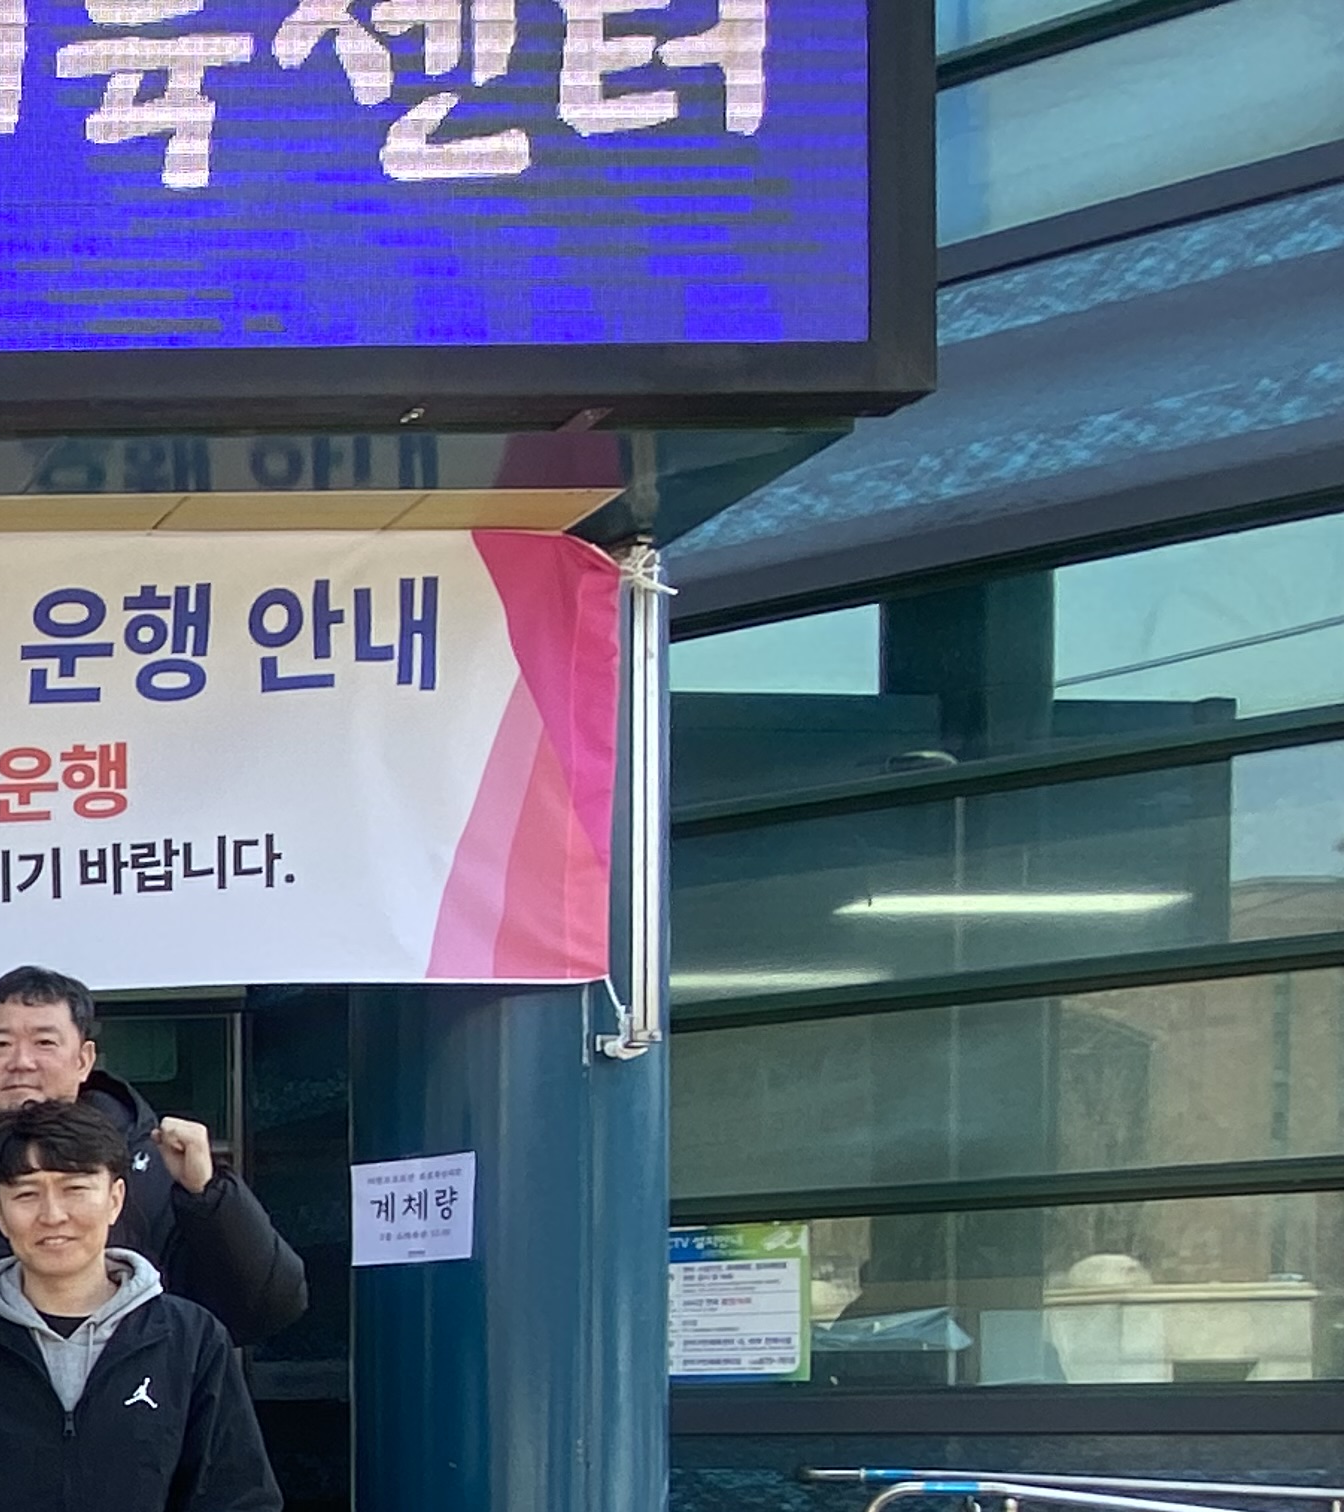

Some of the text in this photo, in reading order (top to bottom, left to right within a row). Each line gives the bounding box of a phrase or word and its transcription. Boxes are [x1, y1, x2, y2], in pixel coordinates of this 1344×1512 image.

[20, 581, 210, 705] 운행
[248, 576, 439, 692] 안내
[78, 832, 297, 895] 바랍니다.
